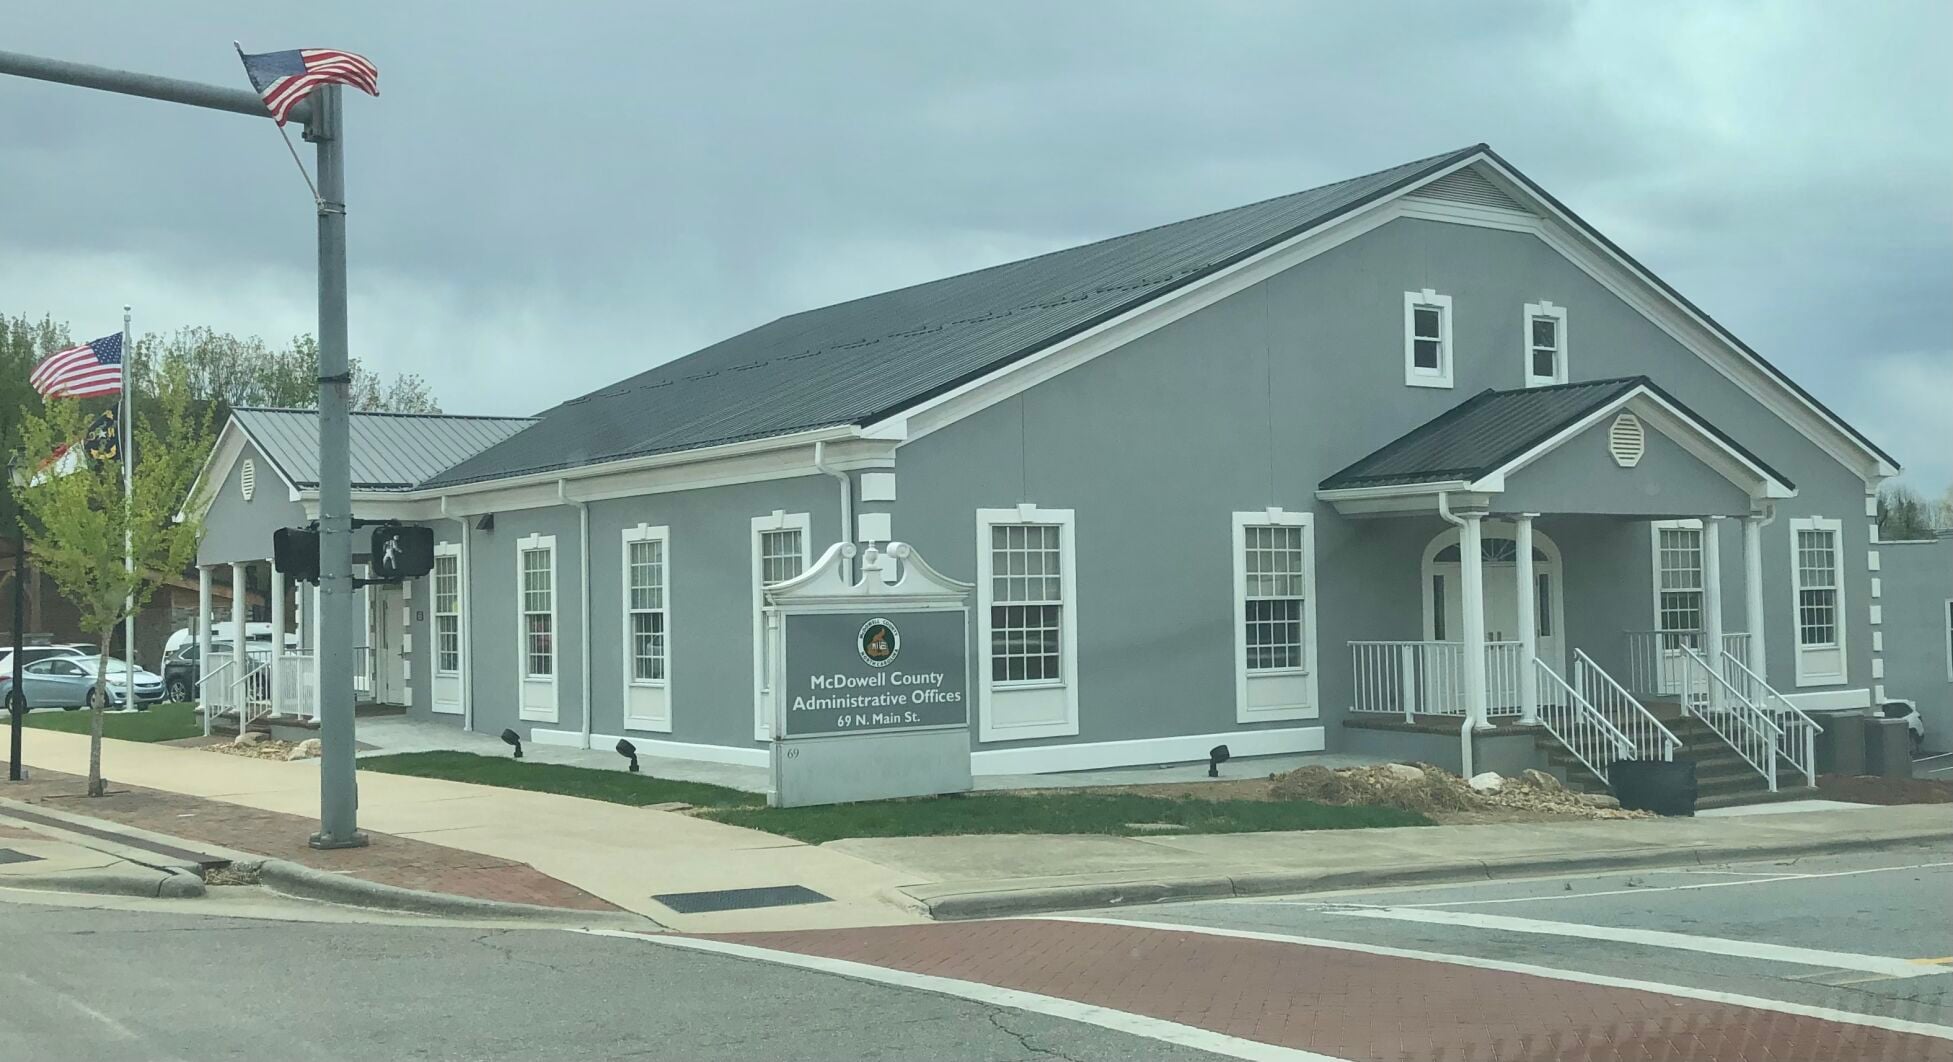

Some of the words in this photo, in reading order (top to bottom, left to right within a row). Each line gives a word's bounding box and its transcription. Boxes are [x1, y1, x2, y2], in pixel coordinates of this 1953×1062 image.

[810, 672, 885, 690] McDowell
[890, 671, 944, 687] County
[792, 691, 907, 711] Administrative
[911, 689, 961, 704] Offices
[837, 714, 851, 727] 69
[856, 714, 869, 726] N.
[872, 712, 901, 725] Main
[905, 711, 920, 723] St.
[787, 748, 800, 760] 69
